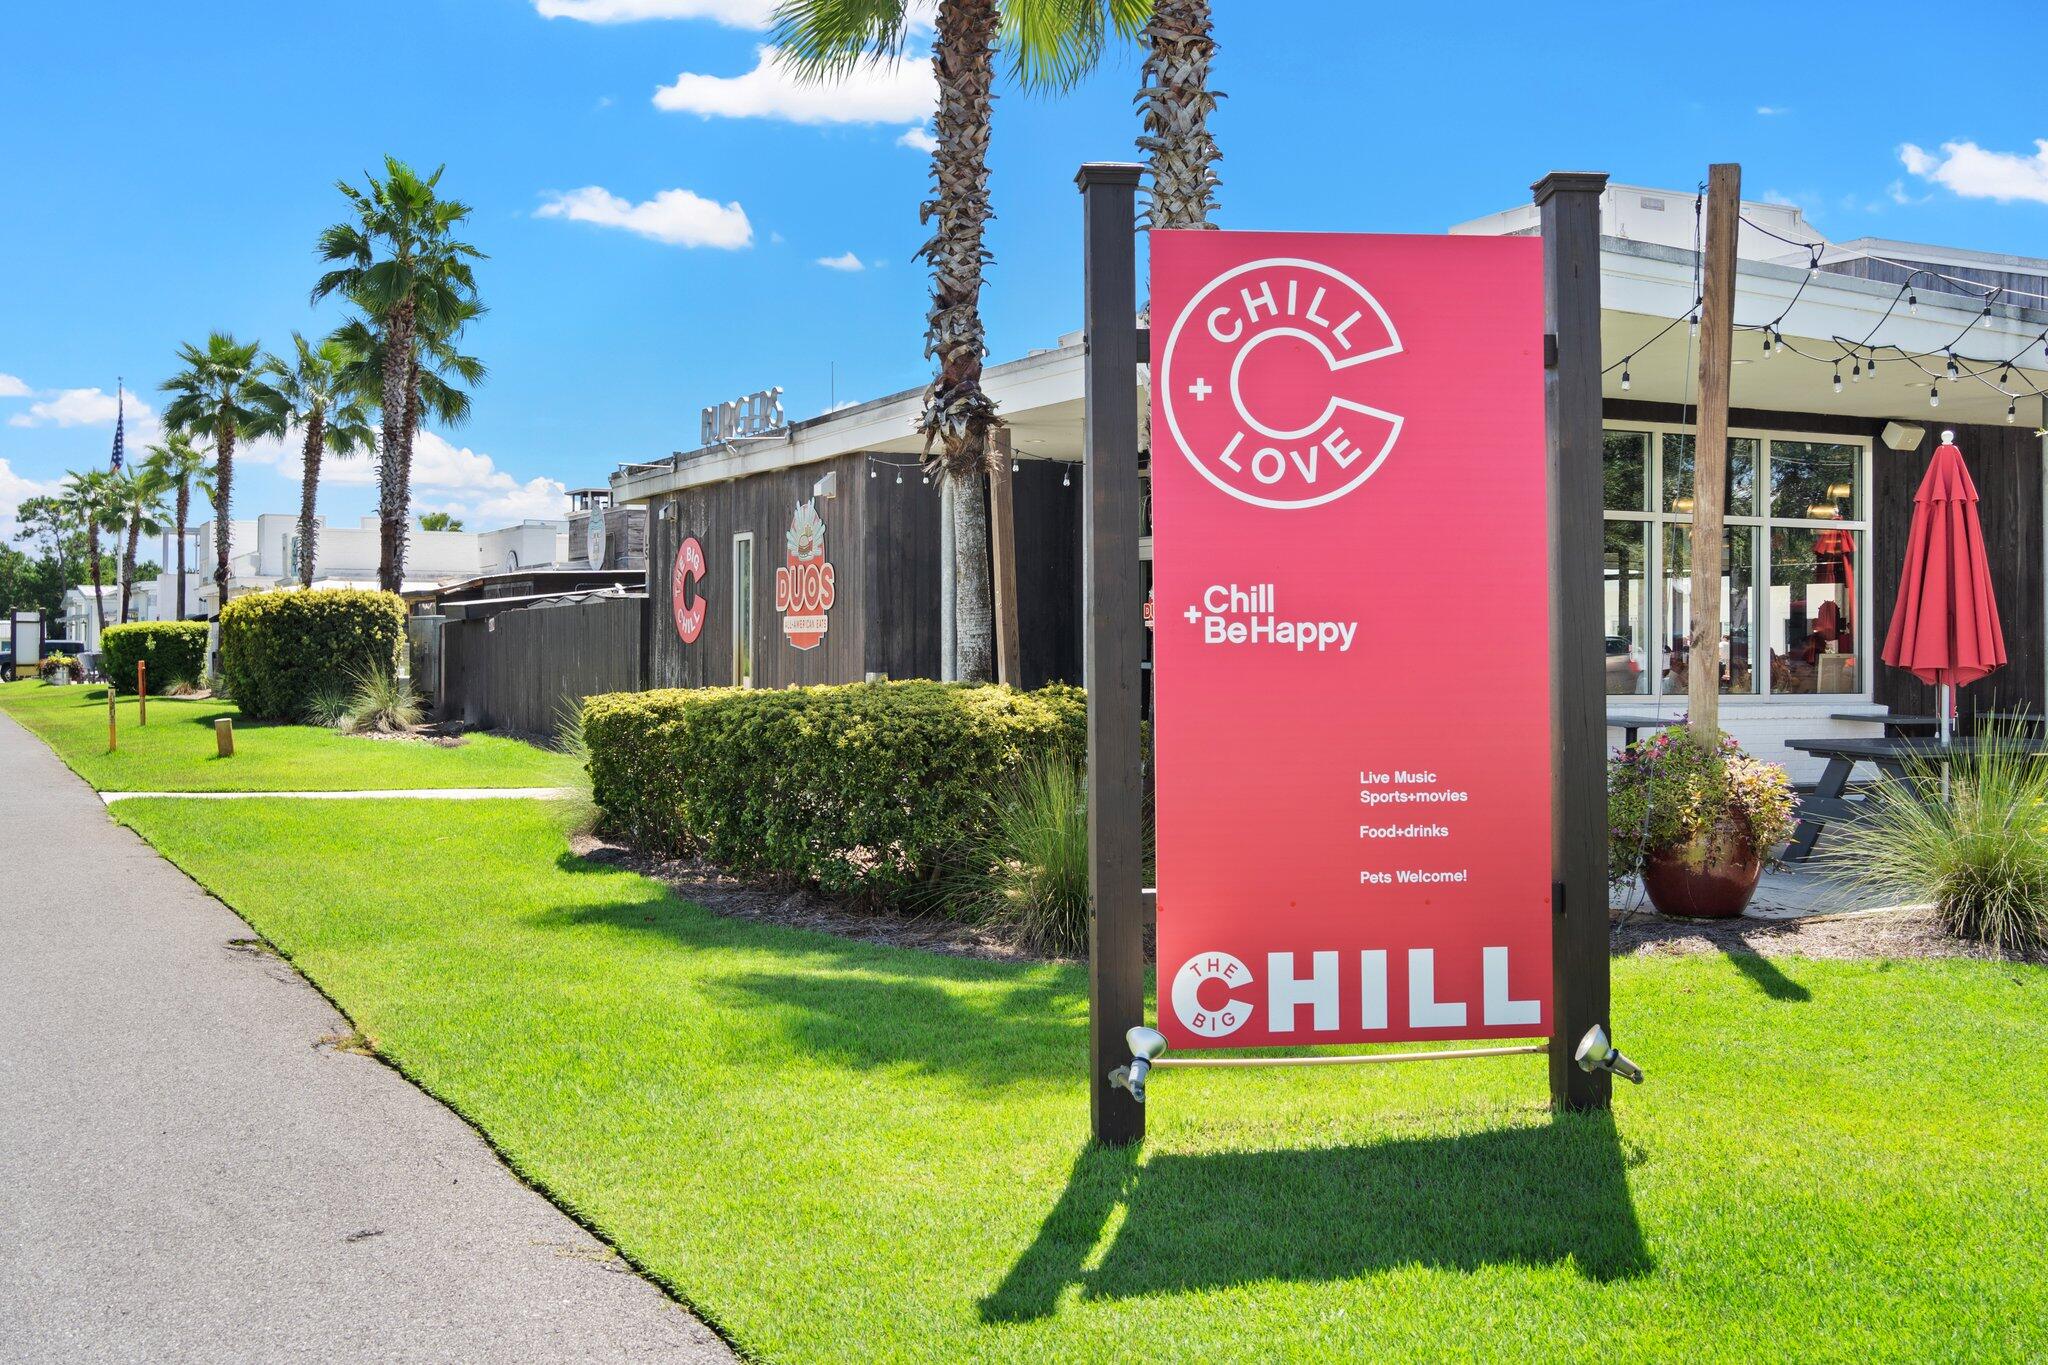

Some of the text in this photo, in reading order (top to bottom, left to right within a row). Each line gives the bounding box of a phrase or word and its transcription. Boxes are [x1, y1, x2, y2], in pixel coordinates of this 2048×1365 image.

[1207, 280, 1362, 350] CHILL
[1219, 427, 1362, 484] LOVE
[675, 547, 700, 598] THE BIG
[776, 562, 835, 612] DUOS
[1204, 584, 1274, 613] Chill
[677, 608, 700, 634] CHILL
[1360, 771, 1437, 784] Live Music
[1360, 869, 1467, 884] Pets Welcome!
[1190, 958, 1239, 979] THE
[1192, 1012, 1235, 1031] BIG
